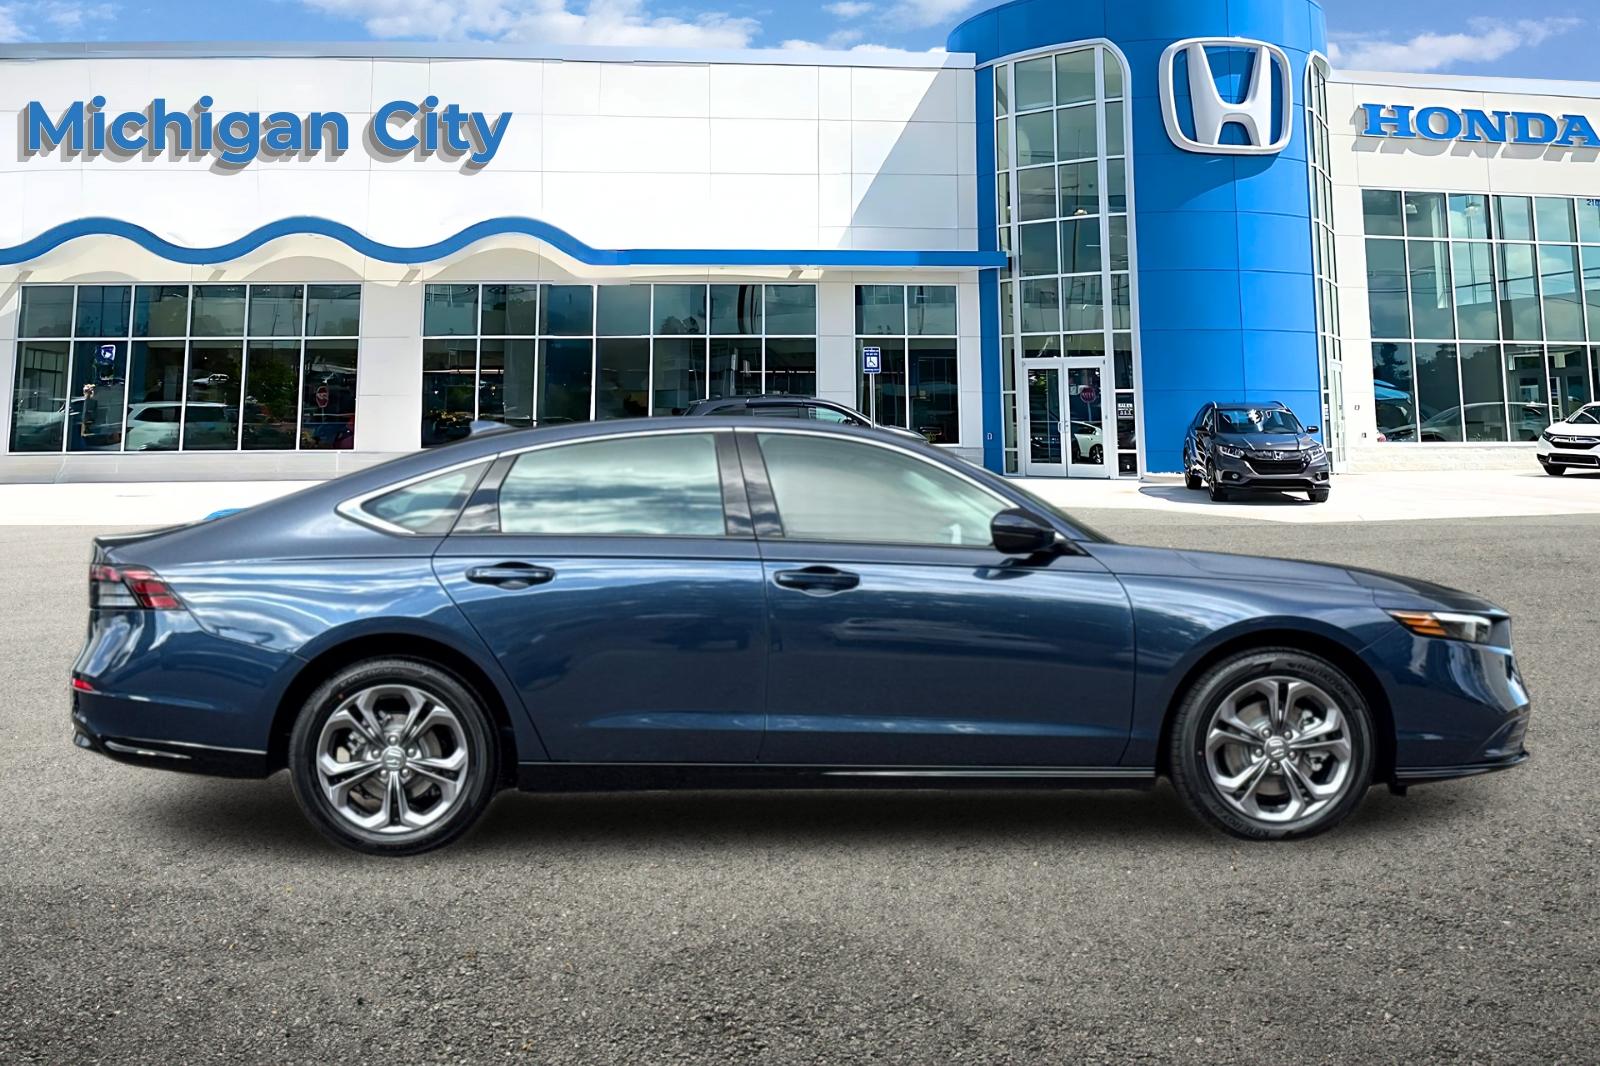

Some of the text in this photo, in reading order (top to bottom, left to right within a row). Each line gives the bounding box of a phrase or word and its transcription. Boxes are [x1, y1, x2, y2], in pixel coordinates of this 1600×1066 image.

[28, 95, 513, 164] Michigan City
[1361, 103, 1600, 148] HONDA
